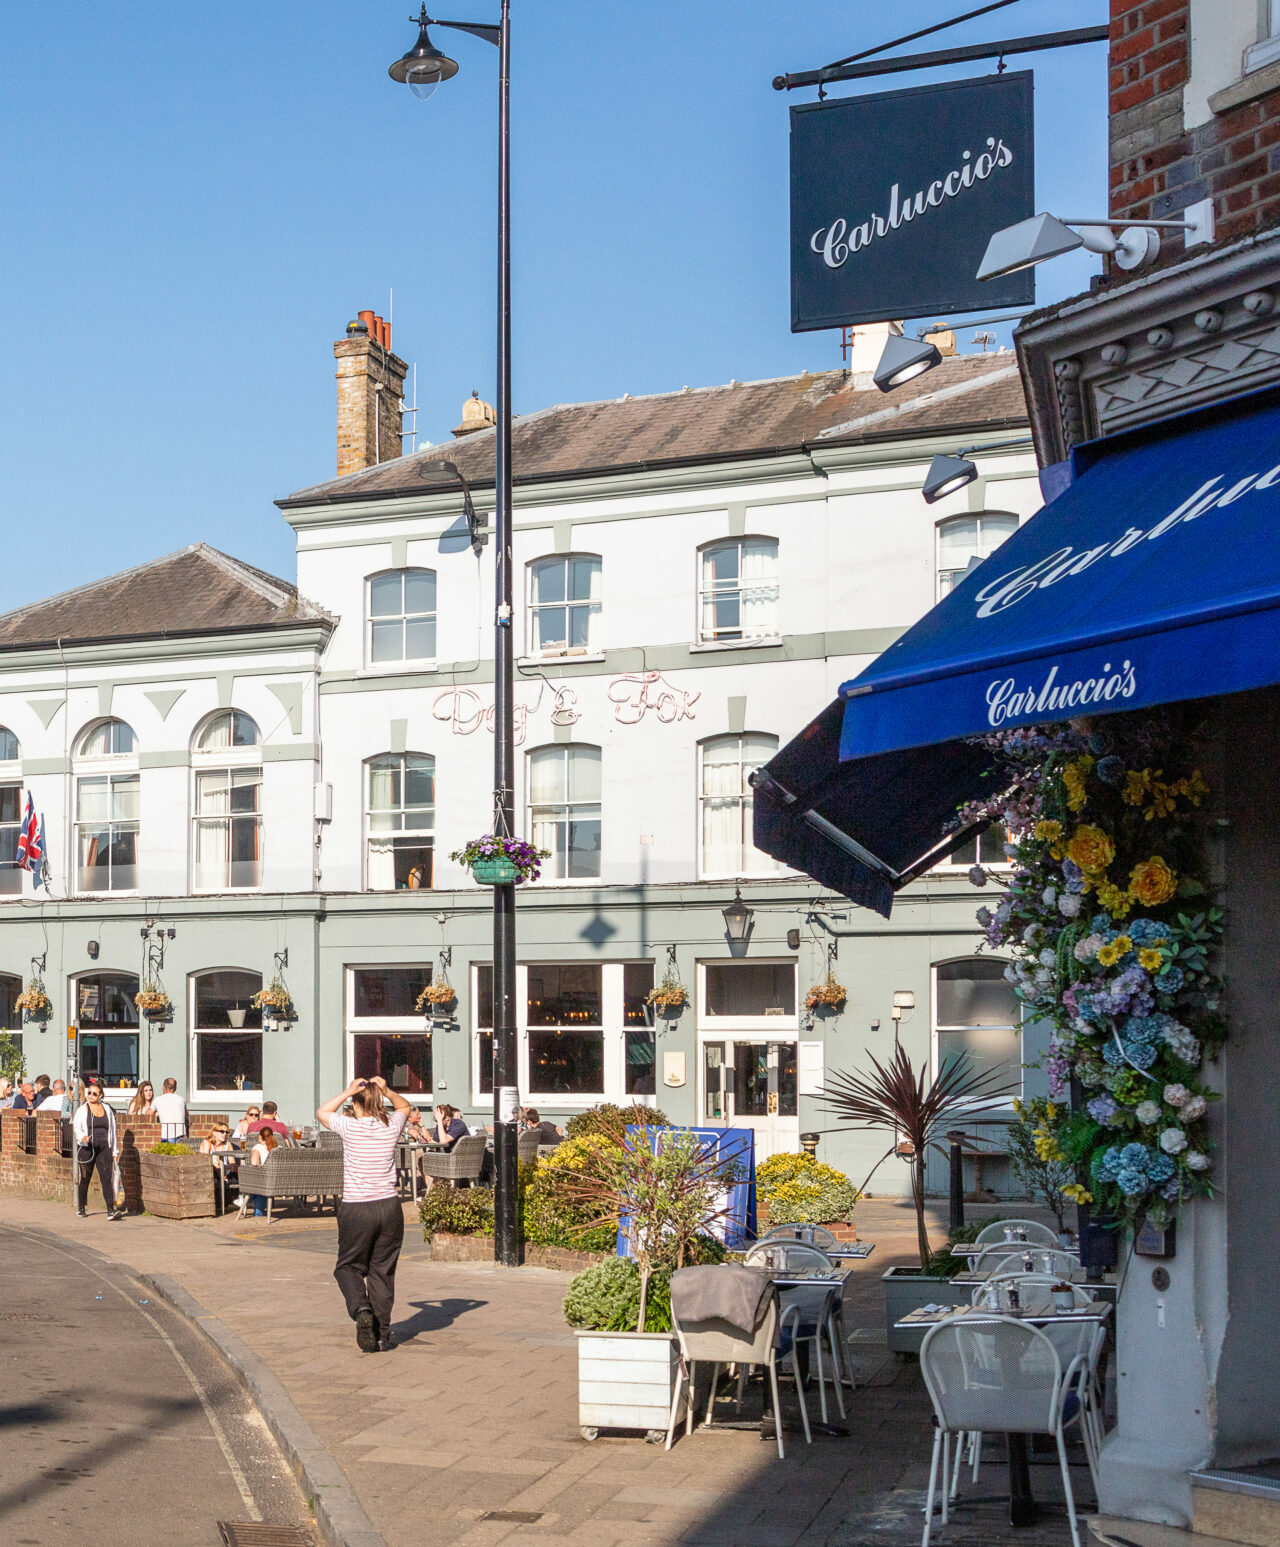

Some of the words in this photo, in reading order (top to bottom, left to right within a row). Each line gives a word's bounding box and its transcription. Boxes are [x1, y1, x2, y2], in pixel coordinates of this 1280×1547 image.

[810, 136, 1013, 268] Carluccio's
[607, 670, 701, 724] Fox
[985, 659, 1136, 727] Carluccio's
